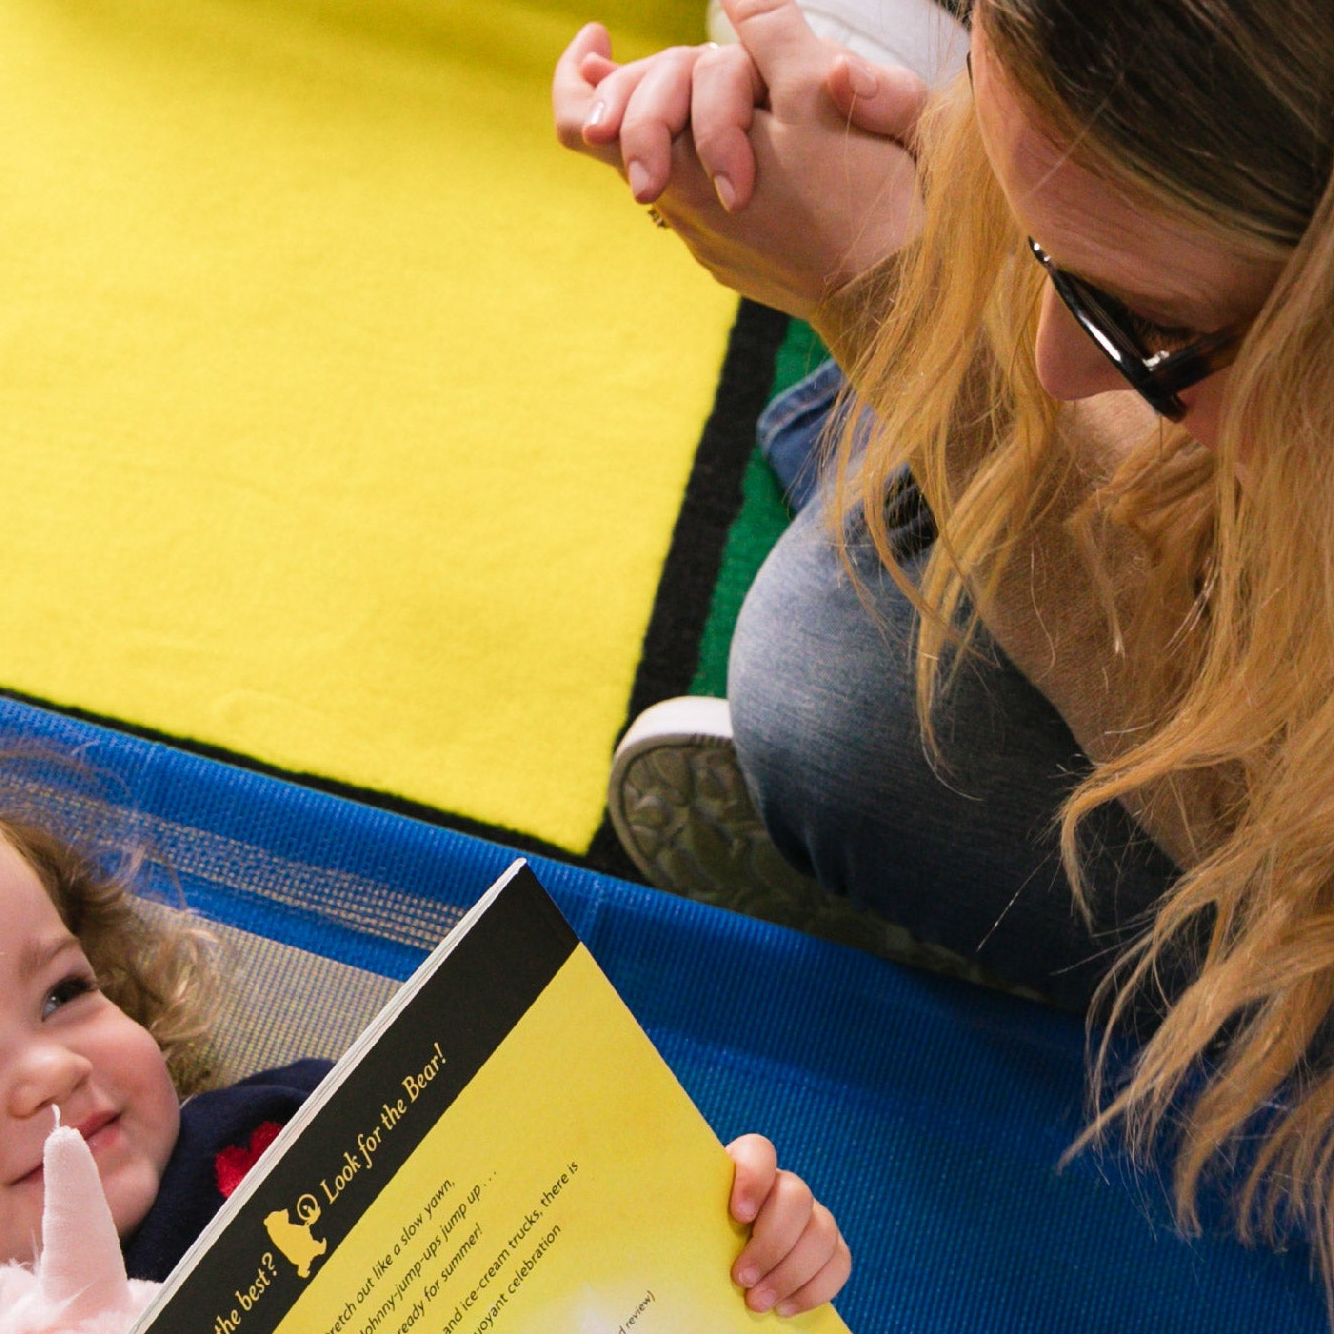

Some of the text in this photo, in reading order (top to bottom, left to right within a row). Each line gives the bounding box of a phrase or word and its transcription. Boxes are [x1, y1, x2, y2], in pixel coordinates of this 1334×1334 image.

[234, 1251, 278, 1311] best?
[319, 1151, 362, 1205] Look
[352, 1126, 382, 1169] for
[380, 1098, 408, 1131] the
[401, 1042, 447, 1104] Bear!
[439, 1203, 467, 1243] jump
[466, 1184, 481, 1205] up
[356, 1277, 375, 1304] out
[372, 1254, 394, 1281] like
[393, 1243, 401, 1256] a
[400, 1214, 423, 1246] slow
[423, 1179, 456, 1220] yawn,
[423, 1279, 440, 1303] for
[440, 1222, 483, 1283] summer!
[459, 1248, 511, 1312] ice-cream
[507, 1209, 544, 1249] trucks,
[540, 1173, 570, 1208] there
[566, 1161, 579, 1175] is
[507, 1224, 562, 1295] celebration
[625, 1289, 656, 1329] review)
